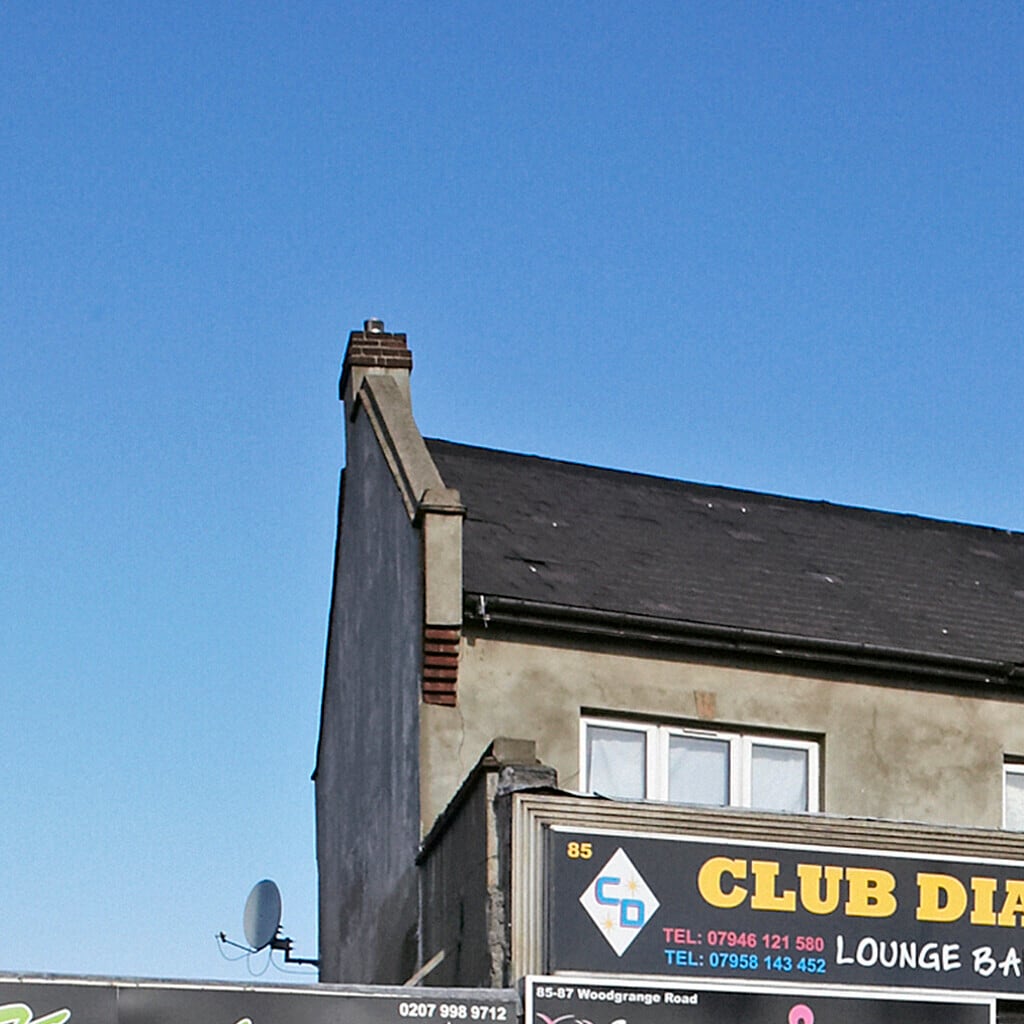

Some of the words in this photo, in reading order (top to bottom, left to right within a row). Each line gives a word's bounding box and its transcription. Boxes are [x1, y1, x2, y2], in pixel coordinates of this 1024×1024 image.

[566, 840, 593, 859] 85
[697, 855, 898, 918] CLUB
[663, 928, 702, 945] TEL:
[707, 931, 757, 949] 07946
[761, 934, 791, 950] 121
[795, 936, 825, 952] 580
[664, 949, 704, 966] TEL:
[709, 953, 758, 969] 07958
[763, 956, 793, 971] 143
[797, 958, 827, 973] 452
[835, 935, 962, 970] LOUNGE
[535, 986, 575, 1000] 85-87
[577, 989, 662, 1004] Woodgrange
[664, 992, 699, 1004] Road
[399, 1004, 435, 1018] 0207
[440, 1005, 467, 1019] 998
[472, 1007, 507, 1020] 9712
